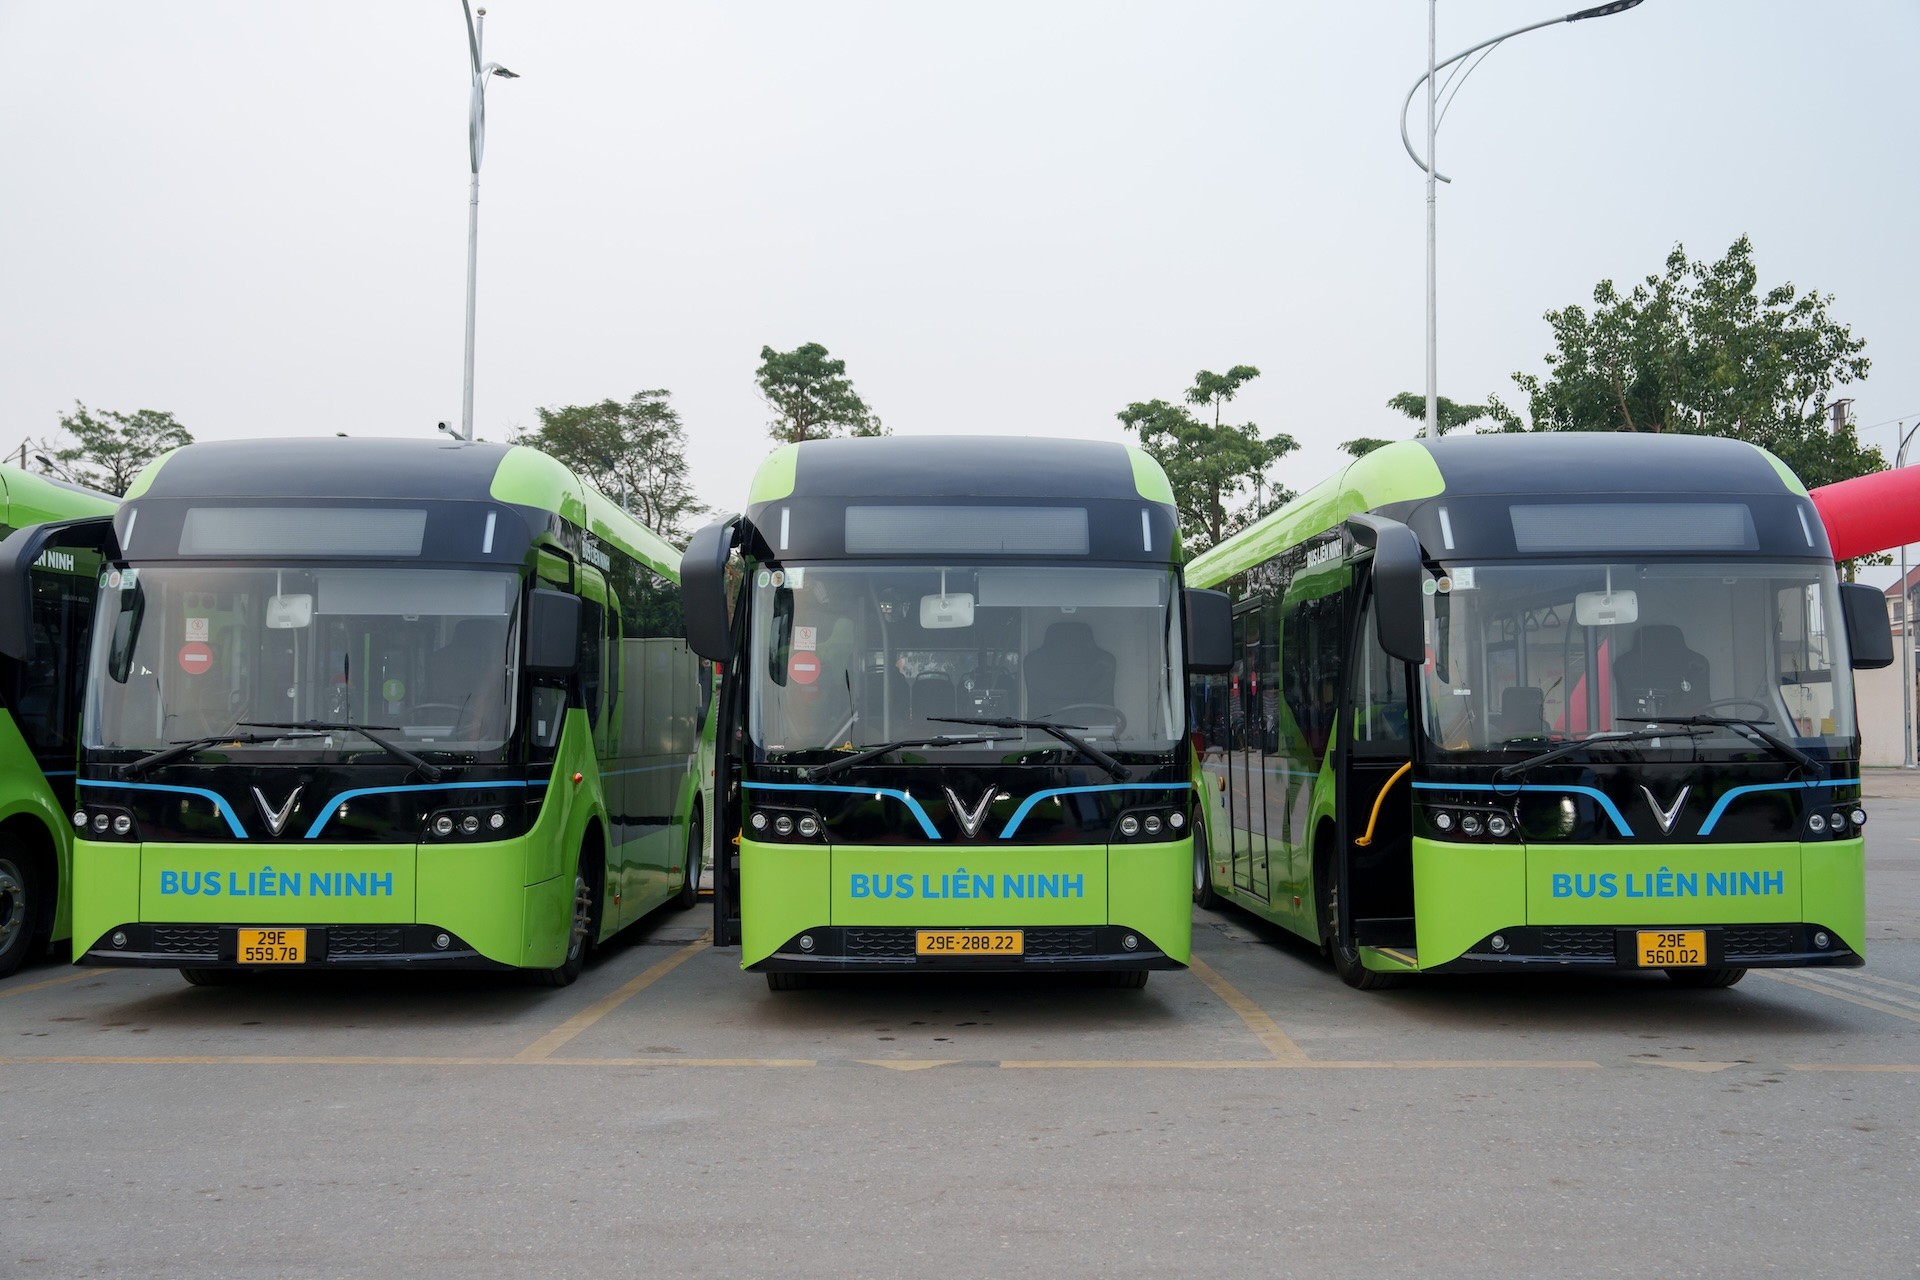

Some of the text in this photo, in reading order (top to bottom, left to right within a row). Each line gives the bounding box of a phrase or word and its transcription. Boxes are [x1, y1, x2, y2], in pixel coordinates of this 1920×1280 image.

[48, 550, 74, 572] NINH
[161, 866, 392, 896] BUS LIÊN NINH
[851, 868, 1083, 899] BUS LIÊN NINH
[1552, 866, 1783, 898] BUS LIÊN NINH
[258, 931, 286, 945] 29E
[926, 936, 1014, 950] 29E-288.22
[1657, 933, 1686, 948] 29E
[246, 947, 297, 961] 559.78
[1646, 949, 1698, 964] 560.02
